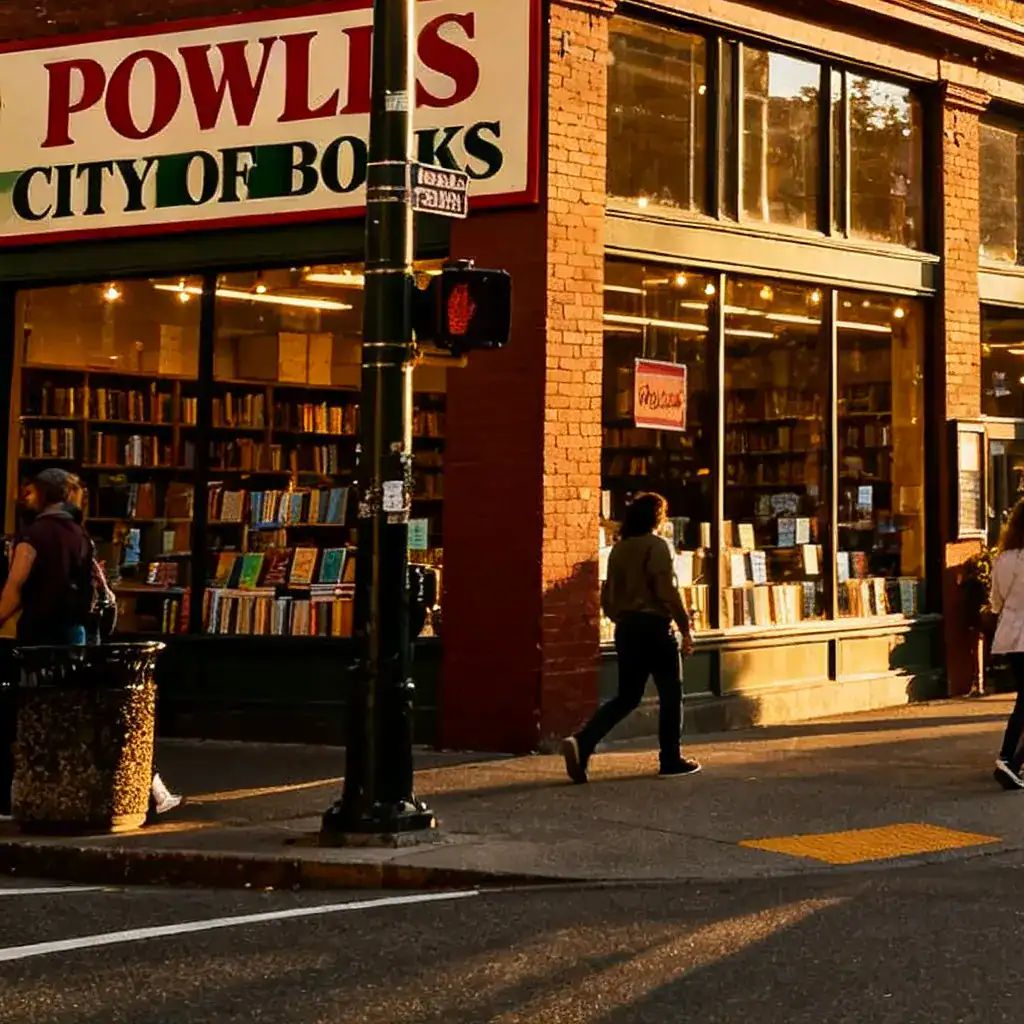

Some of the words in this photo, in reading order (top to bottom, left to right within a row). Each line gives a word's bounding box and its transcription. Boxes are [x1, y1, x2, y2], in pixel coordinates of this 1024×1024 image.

[12, 156, 159, 221] CITY
[181, 146, 254, 206] OF
[286, 120, 503, 196] BOKS
